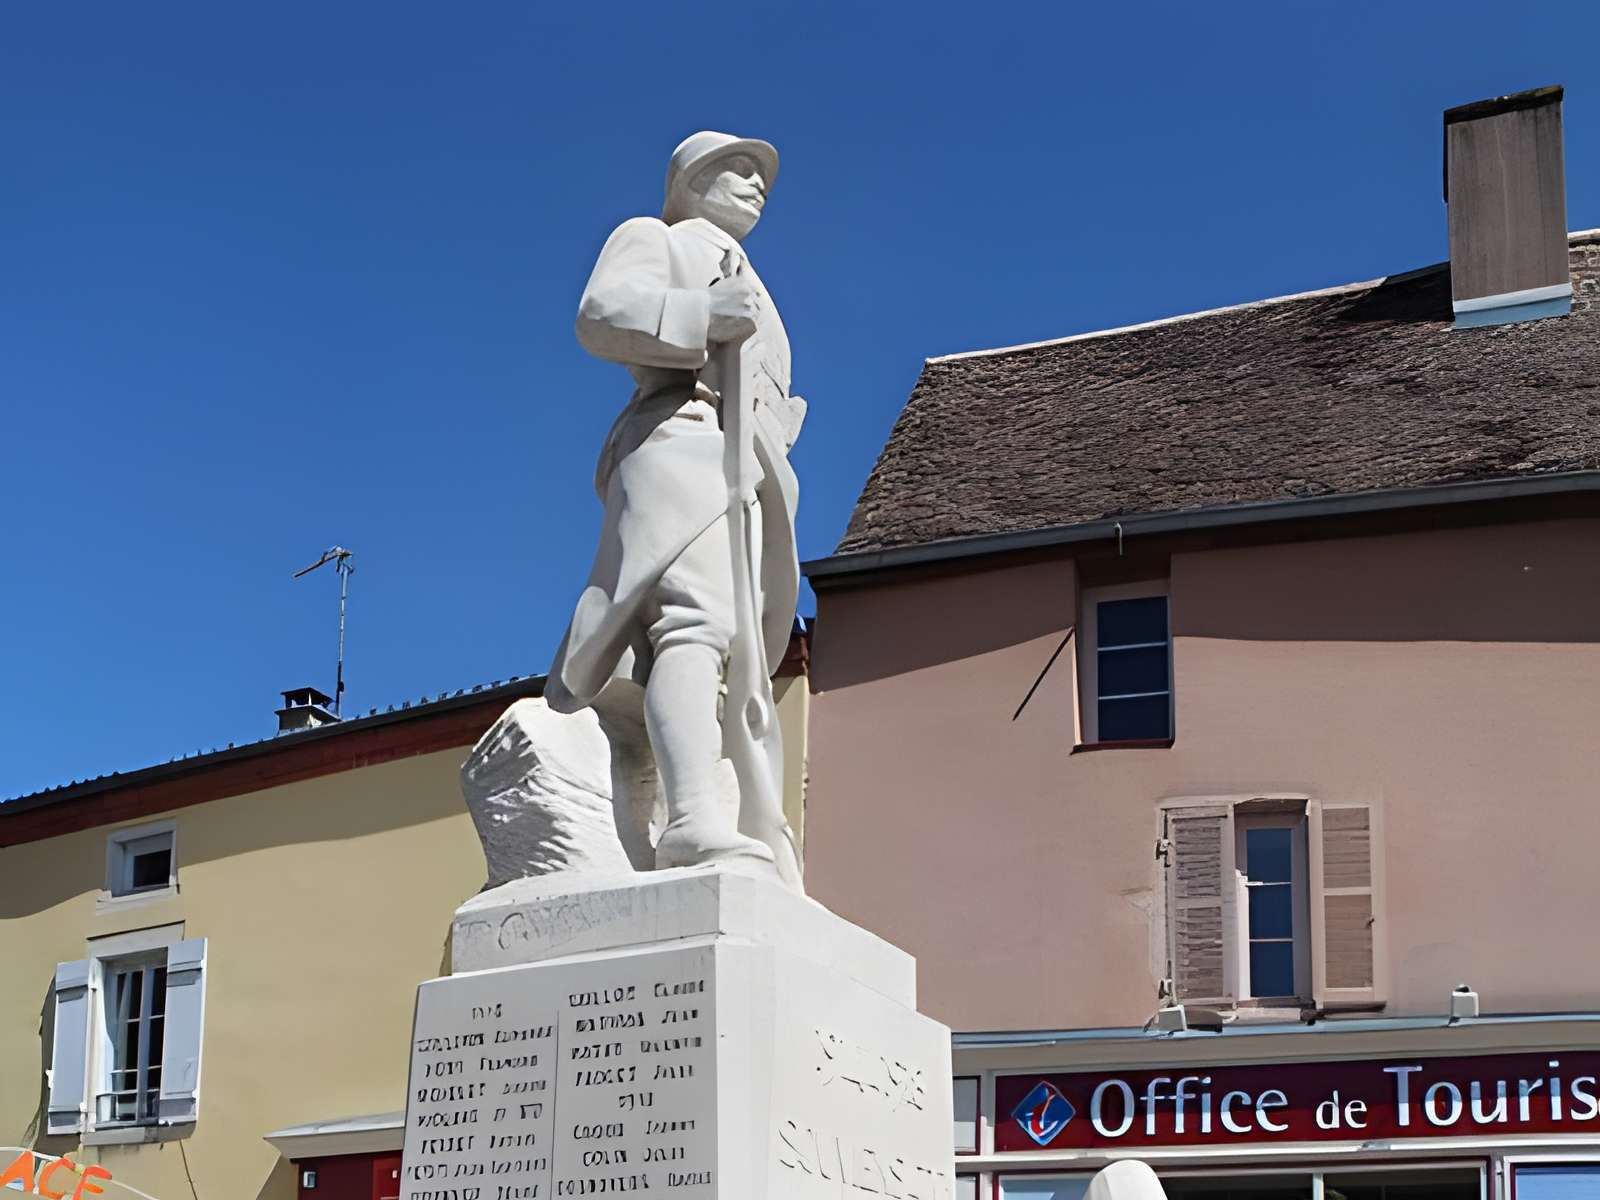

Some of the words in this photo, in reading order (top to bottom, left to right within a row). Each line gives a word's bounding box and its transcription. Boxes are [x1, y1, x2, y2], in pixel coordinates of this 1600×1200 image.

[1090, 1076, 1289, 1138] Office
[1315, 1090, 1368, 1130] de
[1383, 1060, 1600, 1126] Touris
